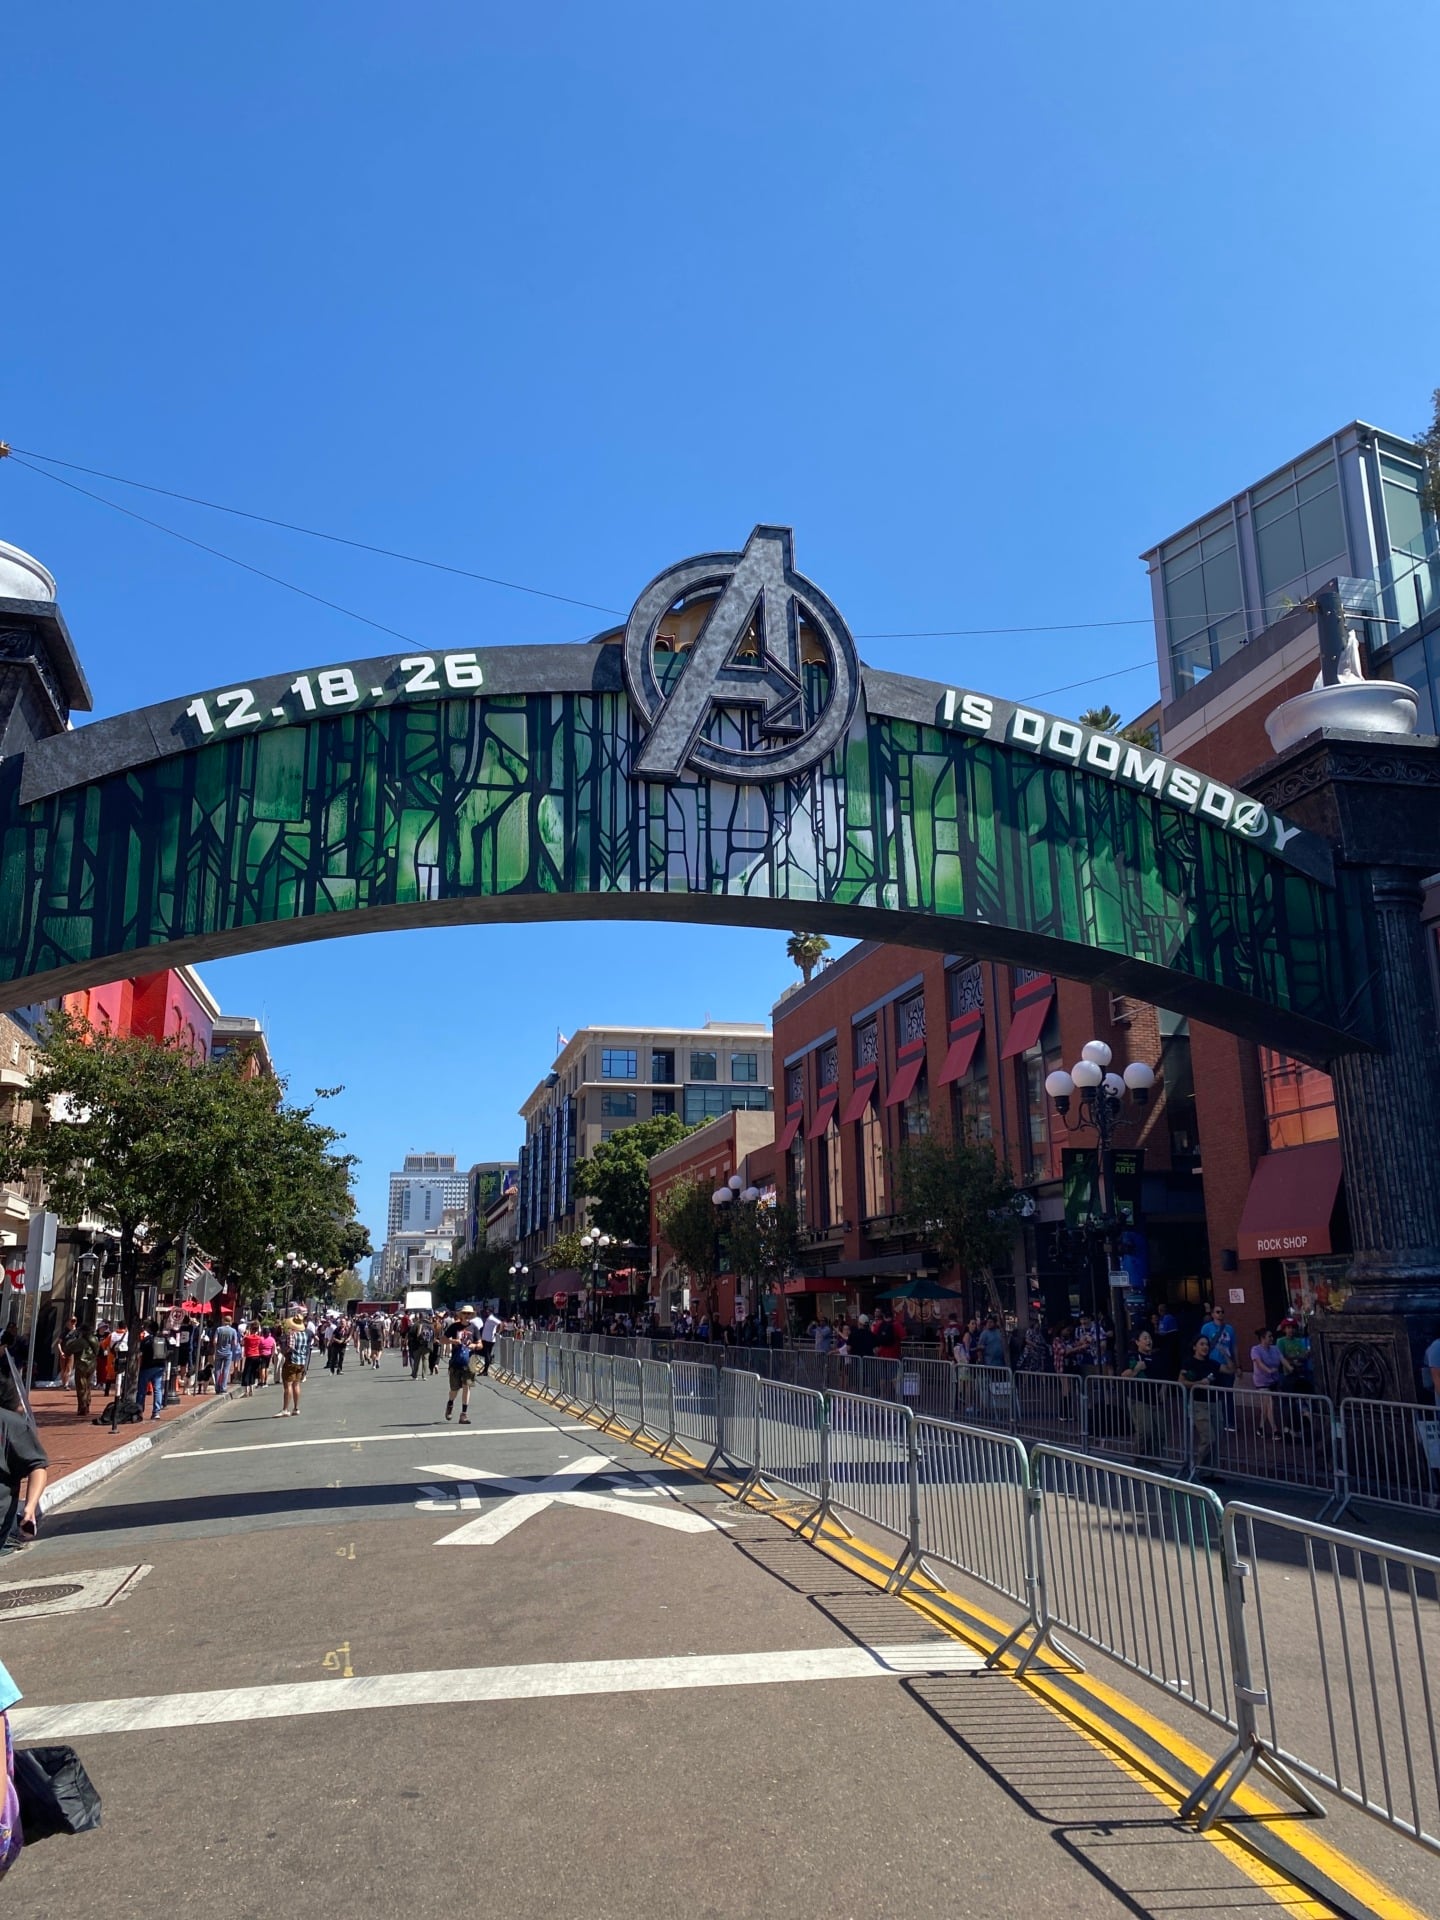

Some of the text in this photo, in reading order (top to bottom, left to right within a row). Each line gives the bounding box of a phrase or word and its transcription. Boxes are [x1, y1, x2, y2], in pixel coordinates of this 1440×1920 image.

[943, 689, 1301, 851] IS DOOMSDAY
[1114, 1166, 1136, 1175] ARTS
[1257, 1235, 1308, 1251] ROCK SHOP
